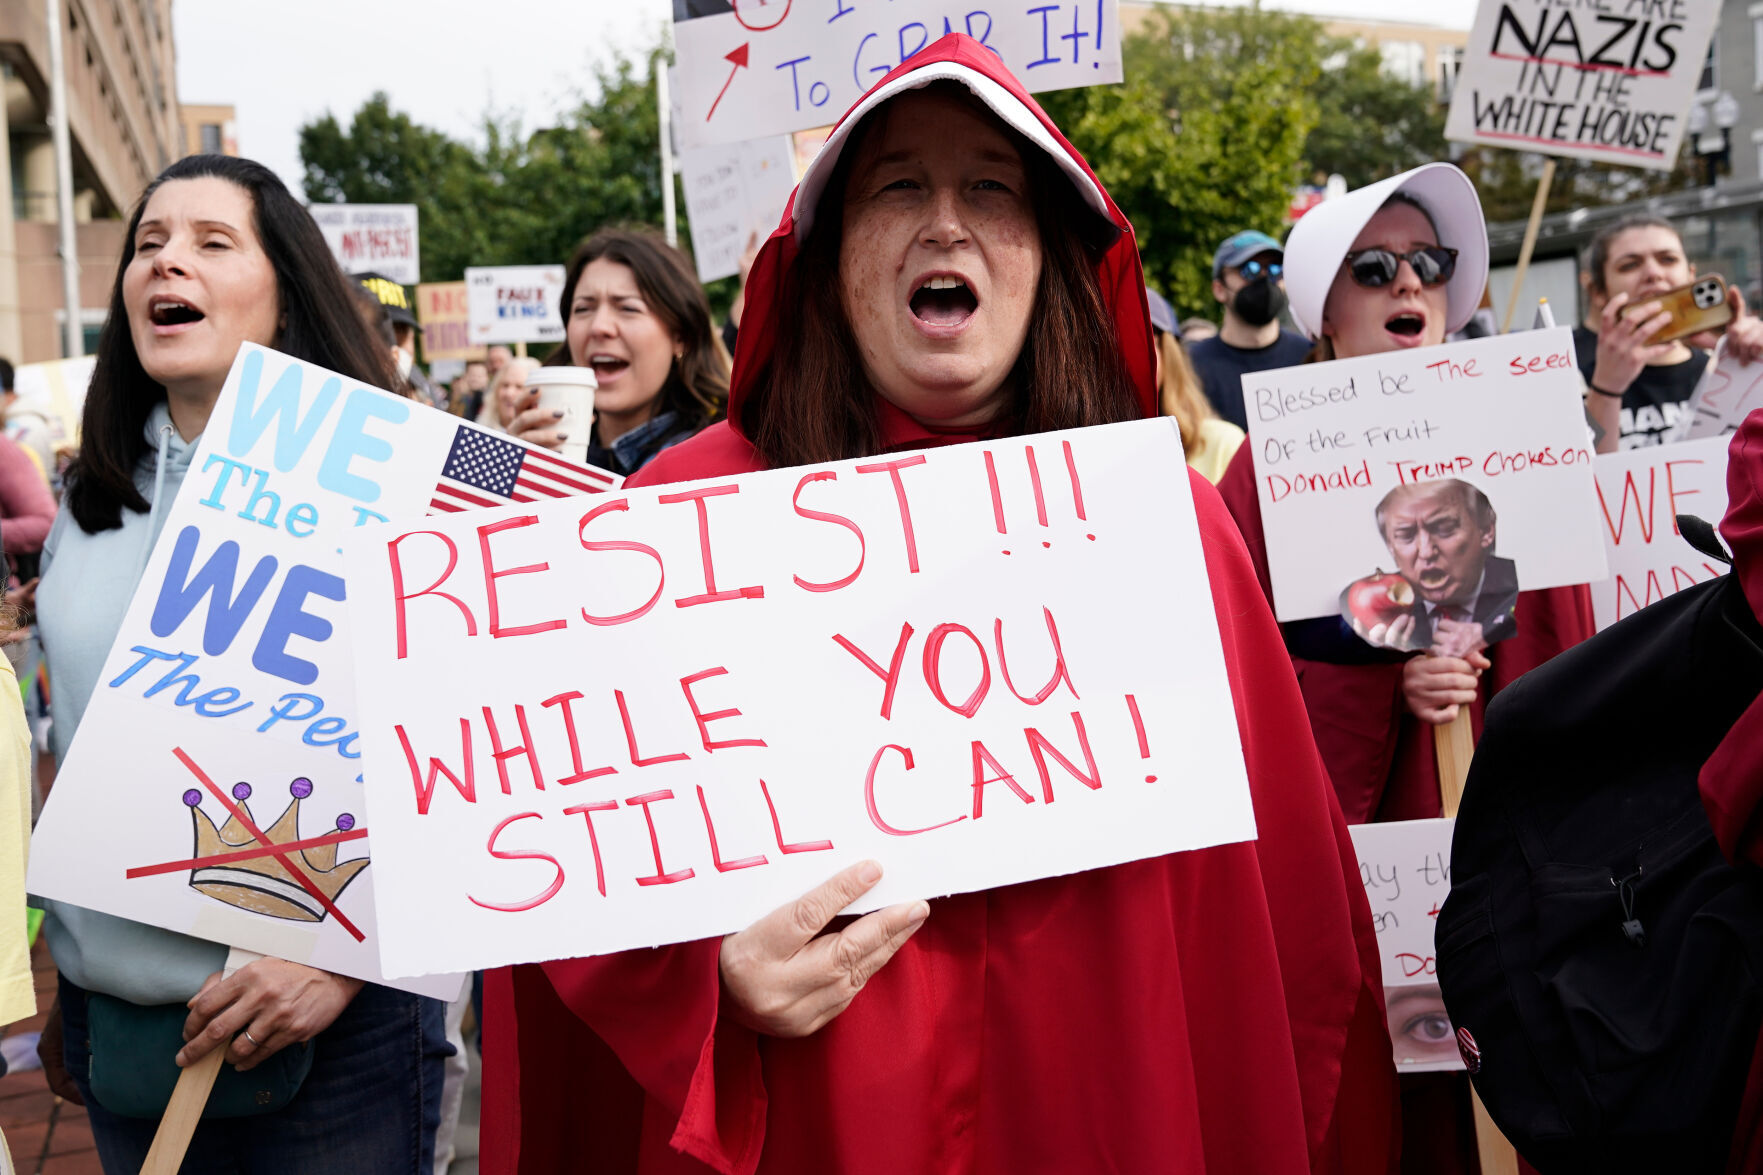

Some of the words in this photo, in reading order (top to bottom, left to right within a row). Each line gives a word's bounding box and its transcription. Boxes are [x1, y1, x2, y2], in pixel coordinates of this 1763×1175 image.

[1491, 4, 1684, 72] NAZIS
[776, 56, 830, 111] To
[1517, 58, 1563, 97] IN
[1574, 65, 1638, 106] THE
[1473, 90, 1576, 141] WHITE
[1578, 105, 1675, 154] HOUSE
[1255, 378, 1358, 421] Blessed
[1380, 369, 1416, 395] be
[1426, 359, 1483, 382] The
[1509, 349, 1571, 376] seed
[226, 349, 410, 503] WE
[1306, 428, 1355, 453] the
[1363, 419, 1439, 448] Fruit
[199, 454, 319, 538] The
[1267, 460, 1372, 502] Donald
[1594, 460, 1717, 546] WE
[387, 455, 927, 660] RESIST
[150, 525, 346, 685] WE
[109, 645, 254, 718] The
[394, 666, 768, 815] WHILE
[832, 605, 1081, 720] YOU
[467, 778, 834, 912] STILL
